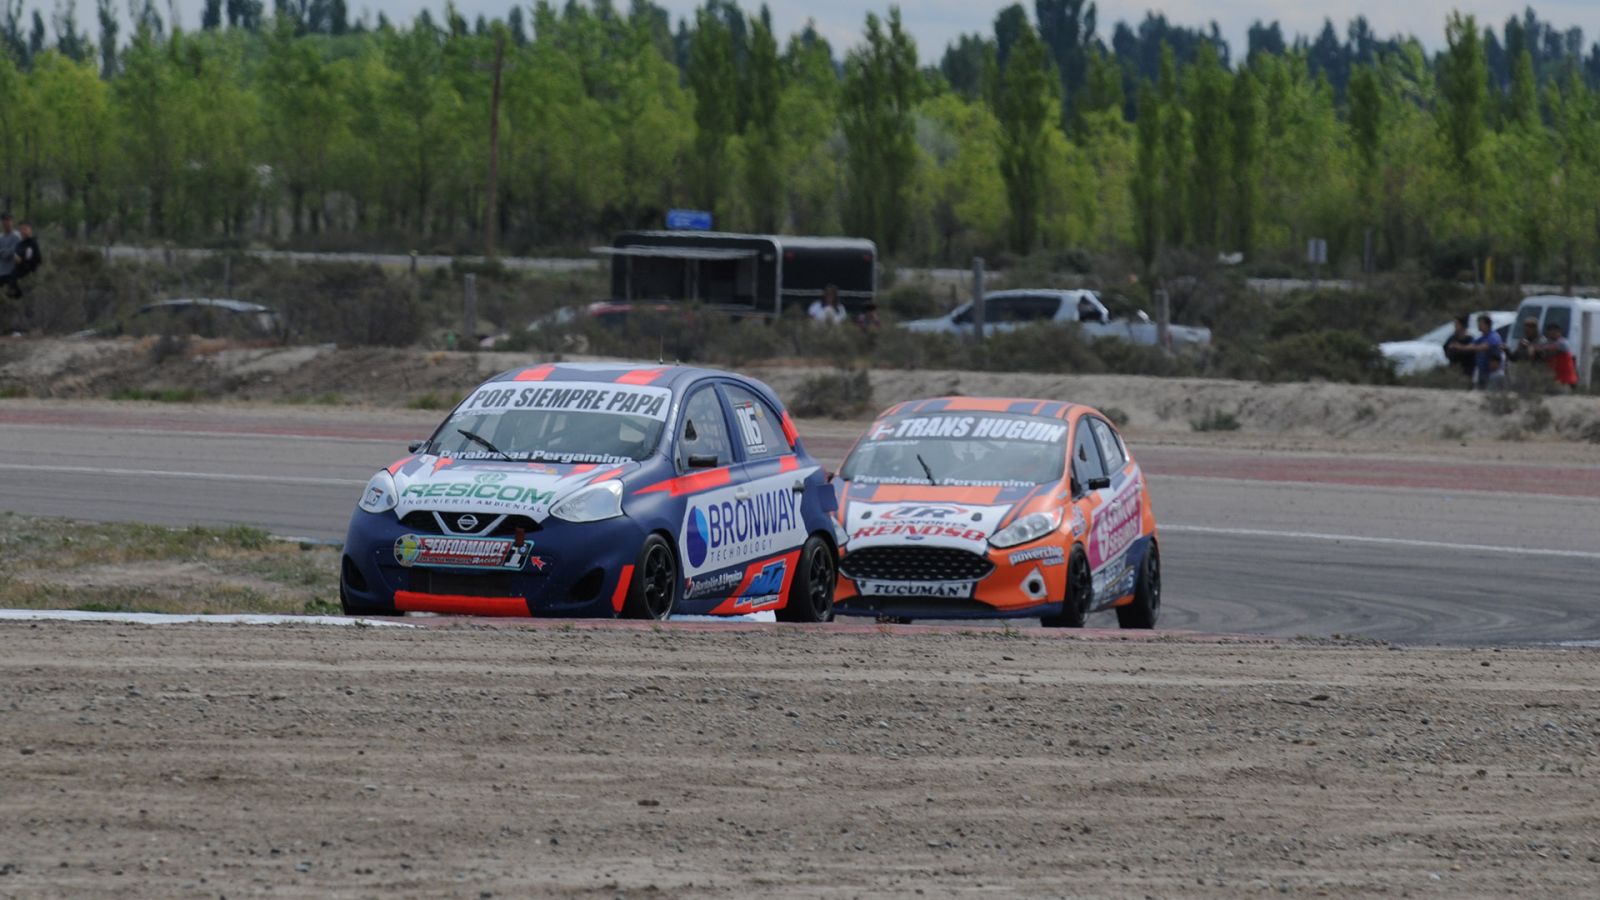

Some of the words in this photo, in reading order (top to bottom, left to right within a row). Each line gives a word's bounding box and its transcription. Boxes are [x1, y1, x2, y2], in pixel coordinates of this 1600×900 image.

[467, 388, 514, 409] POR
[514, 387, 609, 411] SIEMPRE
[606, 391, 666, 417] PAPÁ
[735, 406, 763, 446] 116
[894, 417, 975, 438] TRANS
[971, 418, 1068, 442] HUGUIN
[531, 450, 634, 464] Pergamino
[401, 483, 556, 505] RESICOM
[476, 500, 543, 513] AMBIENTAL
[708, 488, 797, 548] BRONWAY
[853, 525, 986, 541] REINOSO
[421, 539, 510, 557] PERFORMANCE
[710, 539, 773, 562] TECHNOLOGY
[874, 583, 959, 597] TUCUMÁN
